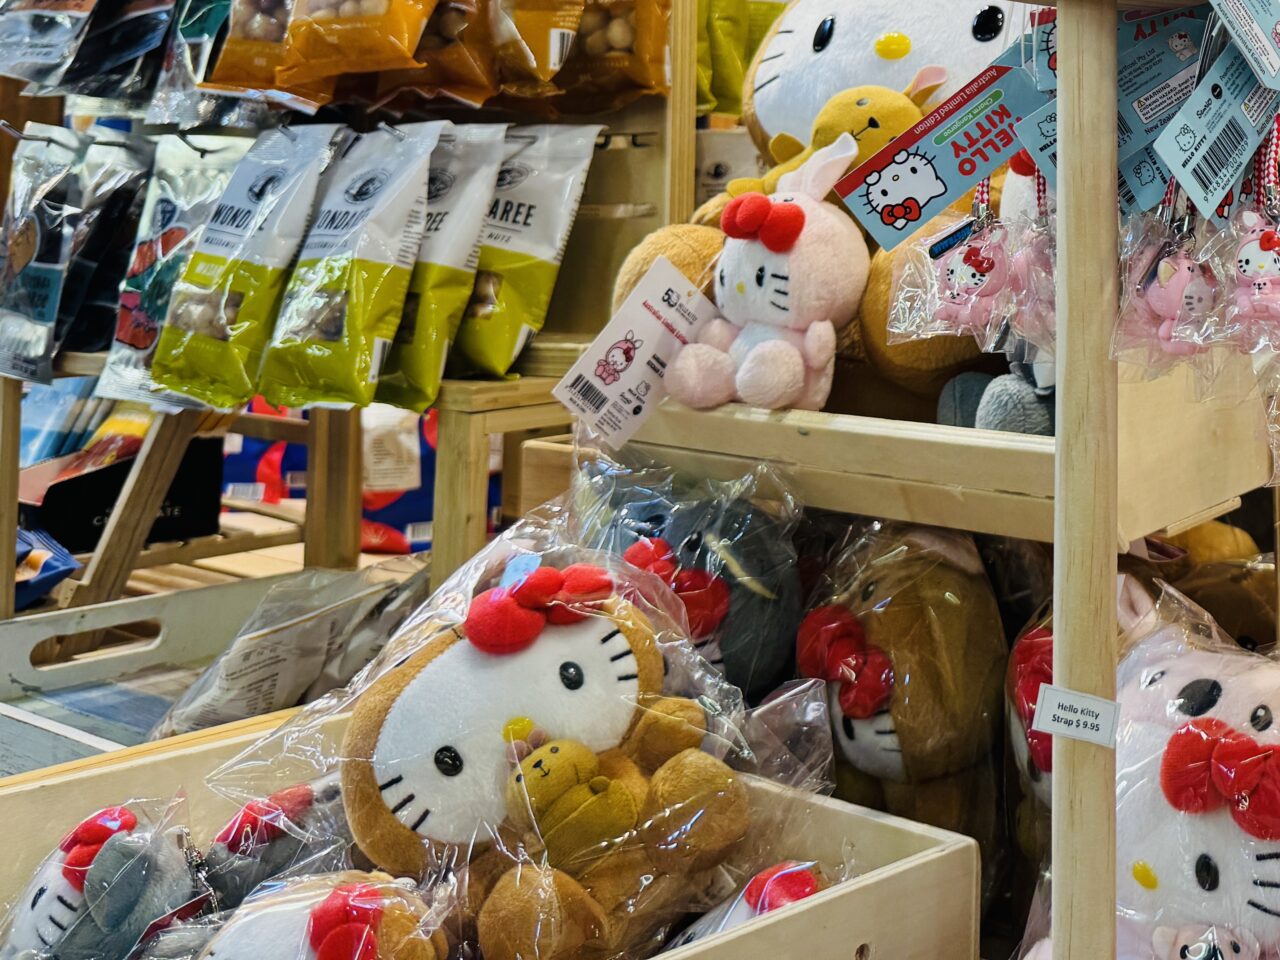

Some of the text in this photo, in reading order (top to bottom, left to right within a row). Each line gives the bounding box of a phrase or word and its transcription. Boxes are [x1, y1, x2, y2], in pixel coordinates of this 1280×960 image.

[1216, 2, 1236, 29] Australia
[1235, 28, 1252, 54] Limited
[1250, 53, 1266, 75] Edition
[914, 68, 998, 135] Australia Limited Edition
[1142, 82, 1171, 102] WARNING
[943, 97, 994, 137] Charm Kangaroo
[1196, 98, 1213, 119] Sanrio
[951, 104, 1012, 158] KITTY
[1144, 122, 1159, 135] New
[1256, 116, 1273, 136] Australia
[957, 123, 1022, 176] ELLO
[1181, 135, 1208, 168] HELLO KITTY
[1210, 168, 1232, 197] 348347
[1231, 140, 1249, 168] 001009
[1221, 179, 1231, 191] MADE
[1233, 161, 1243, 174] CHINA
[1052, 714, 1100, 731] Strap $ 9.95
[1058, 702, 1099, 720] Hello Kitty
